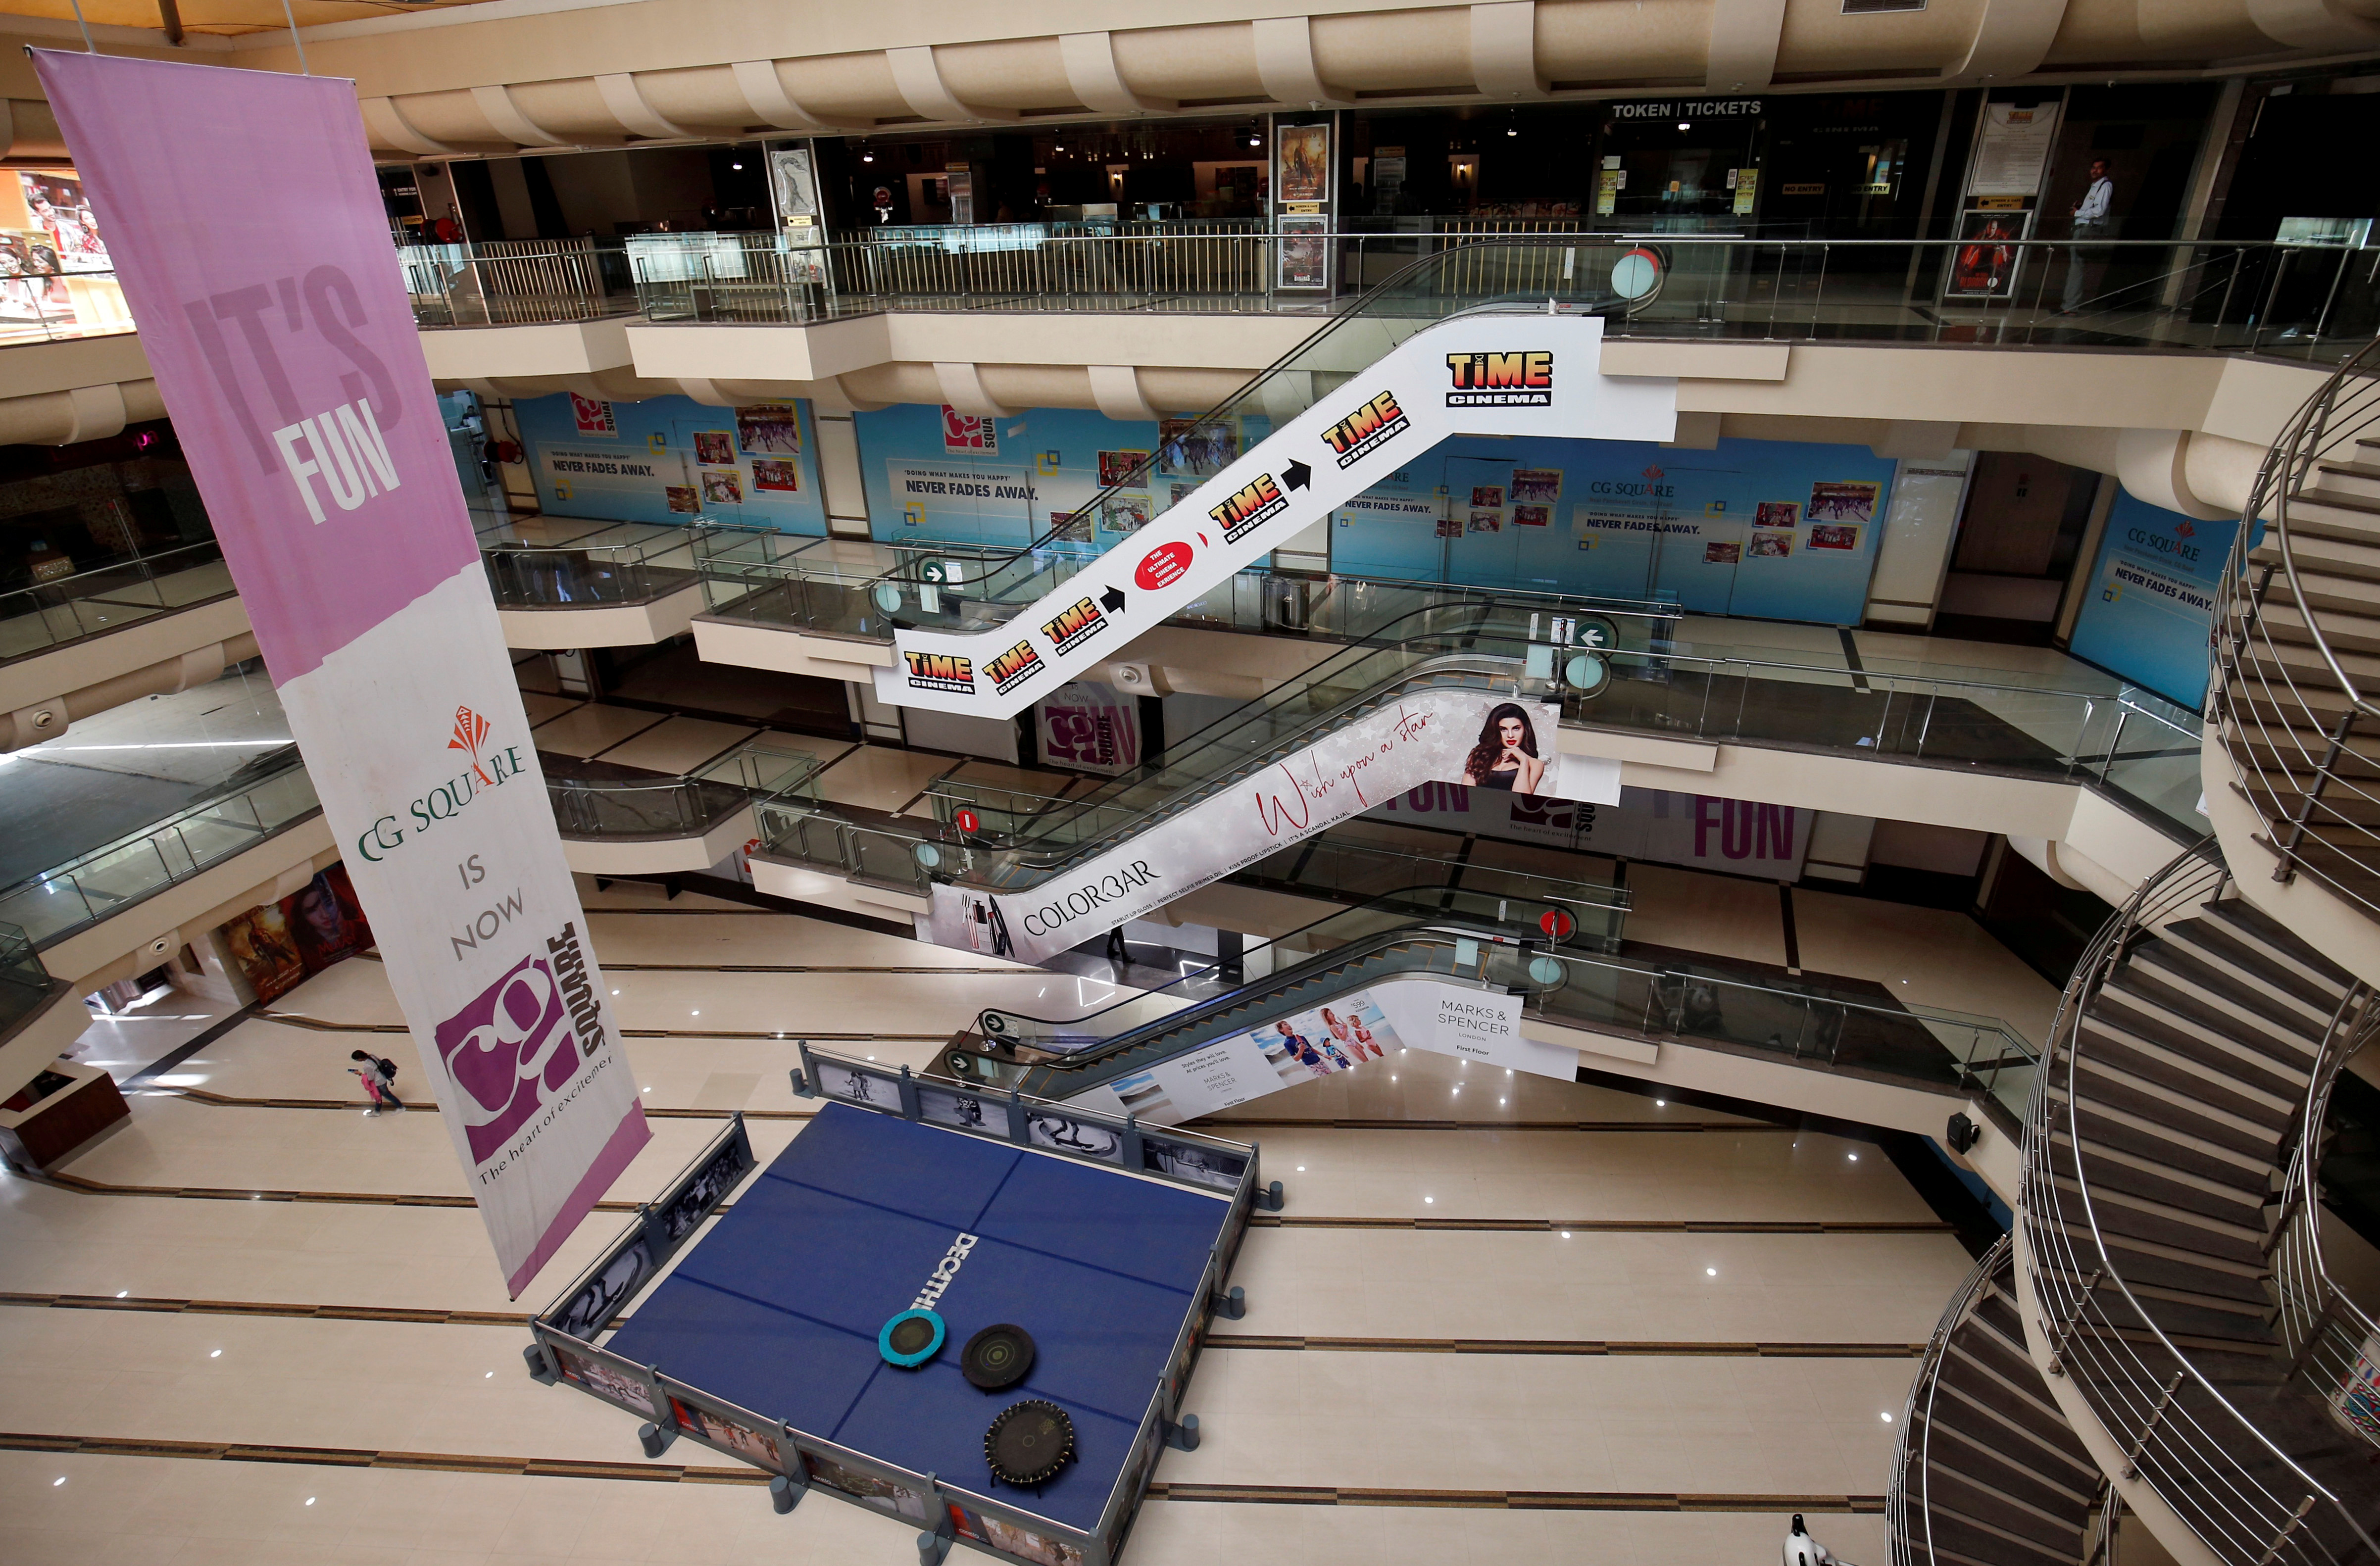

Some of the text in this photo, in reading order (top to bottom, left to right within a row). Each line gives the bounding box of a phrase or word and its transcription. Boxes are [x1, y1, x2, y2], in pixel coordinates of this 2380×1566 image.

[1613, 101, 1761, 118] TOKEN TICKETS
[183, 265, 402, 476] IT'S
[1448, 394, 1548, 404] CINEMA
[982, 417, 995, 448] SQUA
[1339, 419, 1408, 467] CINEMA
[272, 397, 400, 525] FUN
[553, 460, 654, 477] NEVER FADES AWAY.
[906, 480, 1039, 501] NEVER FADES AWAY.
[1591, 482, 1674, 497] CG SQUARE
[1345, 500, 1431, 513] NEVER FADES AWAY.
[1227, 500, 1287, 542] CINEMA
[1587, 519, 1700, 535] NEVER FADES AWAY.
[1149, 550, 1163, 560] THE
[2128, 528, 2146, 544] CG
[2147, 534, 2200, 562] SQUARE
[1147, 552, 1175, 573] ULTIMATE
[1155, 562, 1178, 578] CINEMA
[2136, 565, 2150, 574] WHAT
[2151, 570, 2166, 580] MAKES
[1157, 566, 1185, 587] EXRIENCE
[2115, 567, 2213, 611] NEVER FADES AWAY.
[1057, 620, 1106, 655] CINEMA
[909, 679, 974, 692] CINEMA
[998, 662, 1044, 694] CINEMA
[1064, 693, 1088, 702] NOW
[1096, 715, 1114, 766] SQUARE
[1083, 766, 1114, 774] excitement
[1255, 705, 1433, 836] Wish upon a star
[358, 745, 526, 862] CG SQUARE
[1552, 832, 1591, 841] excitement
[1694, 795, 1794, 860] FUN
[458, 854, 486, 890] IS
[1111, 914, 1129, 925] STARLIT
[1137, 903, 1153, 914] GLOSS
[1157, 891, 1179, 904] PERFECT
[1179, 883, 1195, 894] SELFIE
[1195, 875, 1214, 886] PRIMER
[1240, 854, 1259, 865] PROOF
[1259, 842, 1283, 856] LIPSTICK
[1304, 821, 1331, 834] SCANDAL
[1331, 811, 1350, 822] KAJAL
[450, 887, 523, 961] NOW
[546, 922, 606, 1057] SQUARE
[1441, 1000, 1506, 1021] MARKS &
[1438, 1013, 1509, 1036] SPENCER
[1459, 1032, 1487, 1041] LONDON
[1192, 1064, 1206, 1072] prices
[1203, 1073, 1226, 1084] MARKS
[1207, 1077, 1237, 1091] SPENCER
[480, 1109, 557, 1185] The heart of
